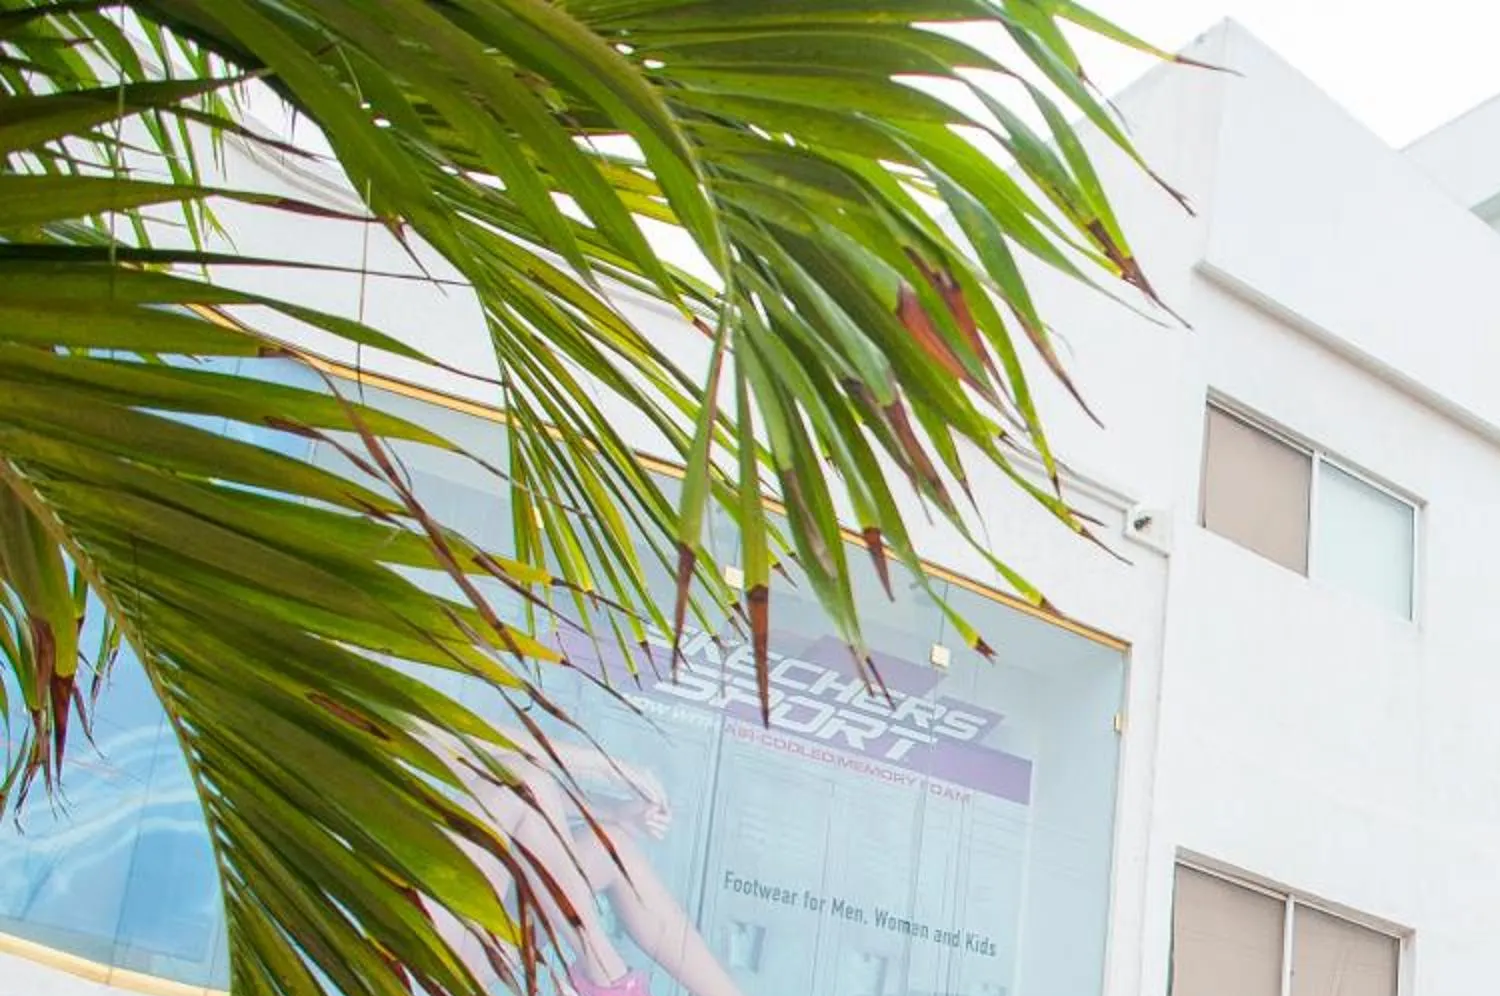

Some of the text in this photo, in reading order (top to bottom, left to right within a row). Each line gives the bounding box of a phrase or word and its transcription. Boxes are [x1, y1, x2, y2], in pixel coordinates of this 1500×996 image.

[654, 668, 938, 762] SPORT
[919, 779, 973, 804] OAM
[723, 871, 798, 906] Footwear
[802, 889, 826, 913] for
[932, 927, 960, 949] and
[964, 931, 997, 957] Kids
